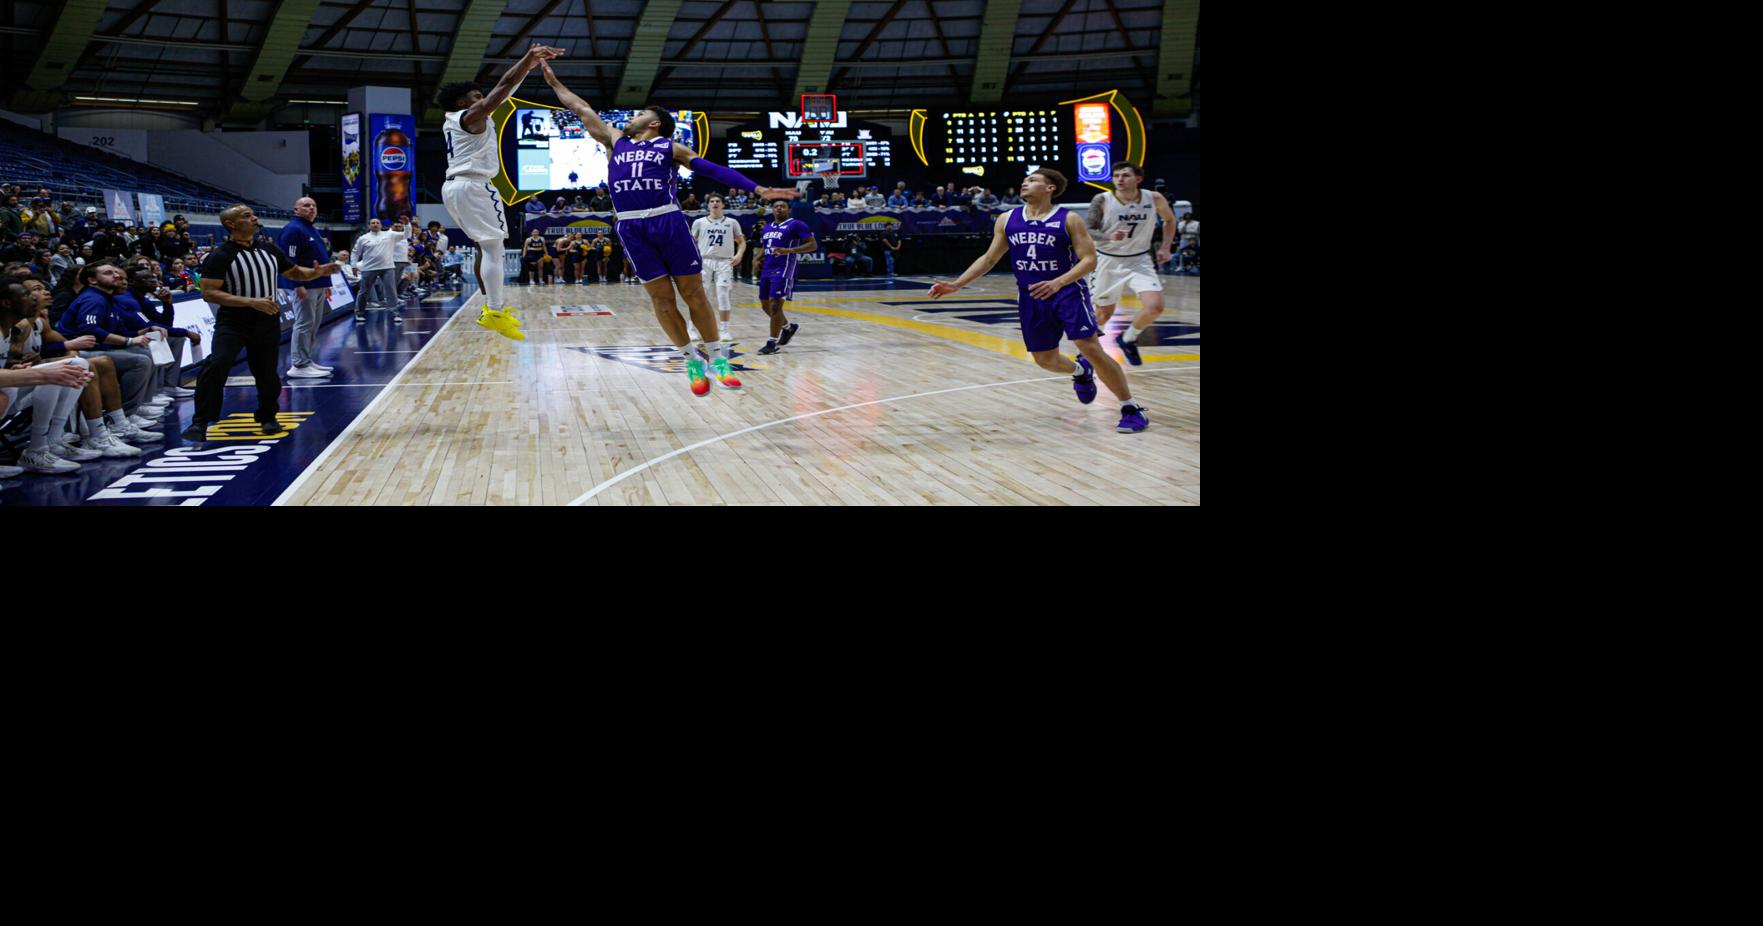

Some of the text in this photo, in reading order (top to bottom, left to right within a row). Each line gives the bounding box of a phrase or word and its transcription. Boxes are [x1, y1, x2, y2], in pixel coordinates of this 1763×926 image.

[92, 136, 115, 146] 202
[614, 150, 665, 166] WEBER
[803, 148, 818, 157] 0.2
[631, 162, 643, 178] 11
[613, 178, 663, 193] STATE
[1118, 213, 1147, 221] NAU
[762, 231, 783, 240] EBER
[1127, 222, 1138, 238] 7
[709, 234, 724, 246] 24
[1008, 232, 1056, 247] WEBER
[1026, 244, 1037, 259] 4
[1015, 260, 1058, 271] STATE
